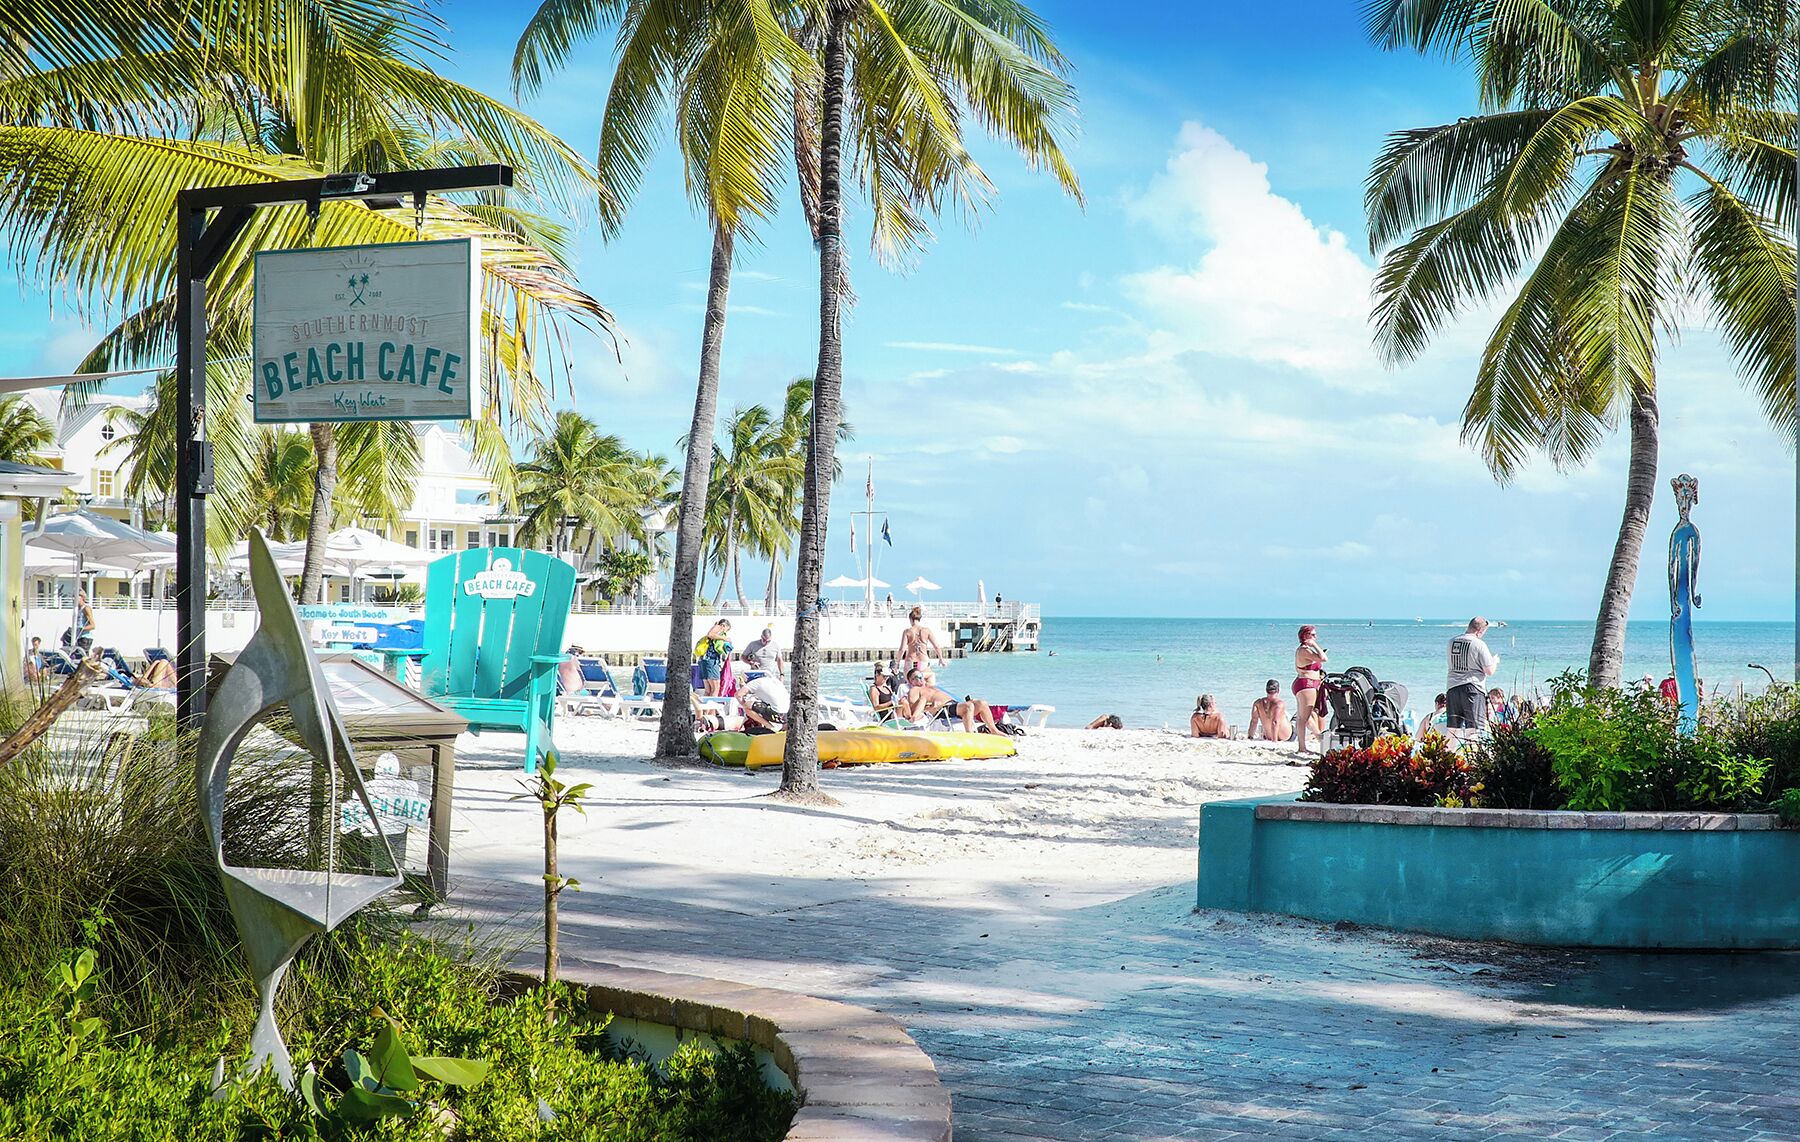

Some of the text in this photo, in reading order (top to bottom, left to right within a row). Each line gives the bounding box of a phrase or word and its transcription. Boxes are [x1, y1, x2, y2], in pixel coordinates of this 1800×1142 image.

[293, 314, 429, 340] SOUTHERNMOST
[262, 341, 461, 400] BEACH CAFE
[334, 391, 386, 415] Key West
[467, 580, 532, 593] BEACH CAFE
[362, 609, 387, 618] Beach
[321, 629, 367, 639] Key West
[393, 797, 427, 822] CAFE
